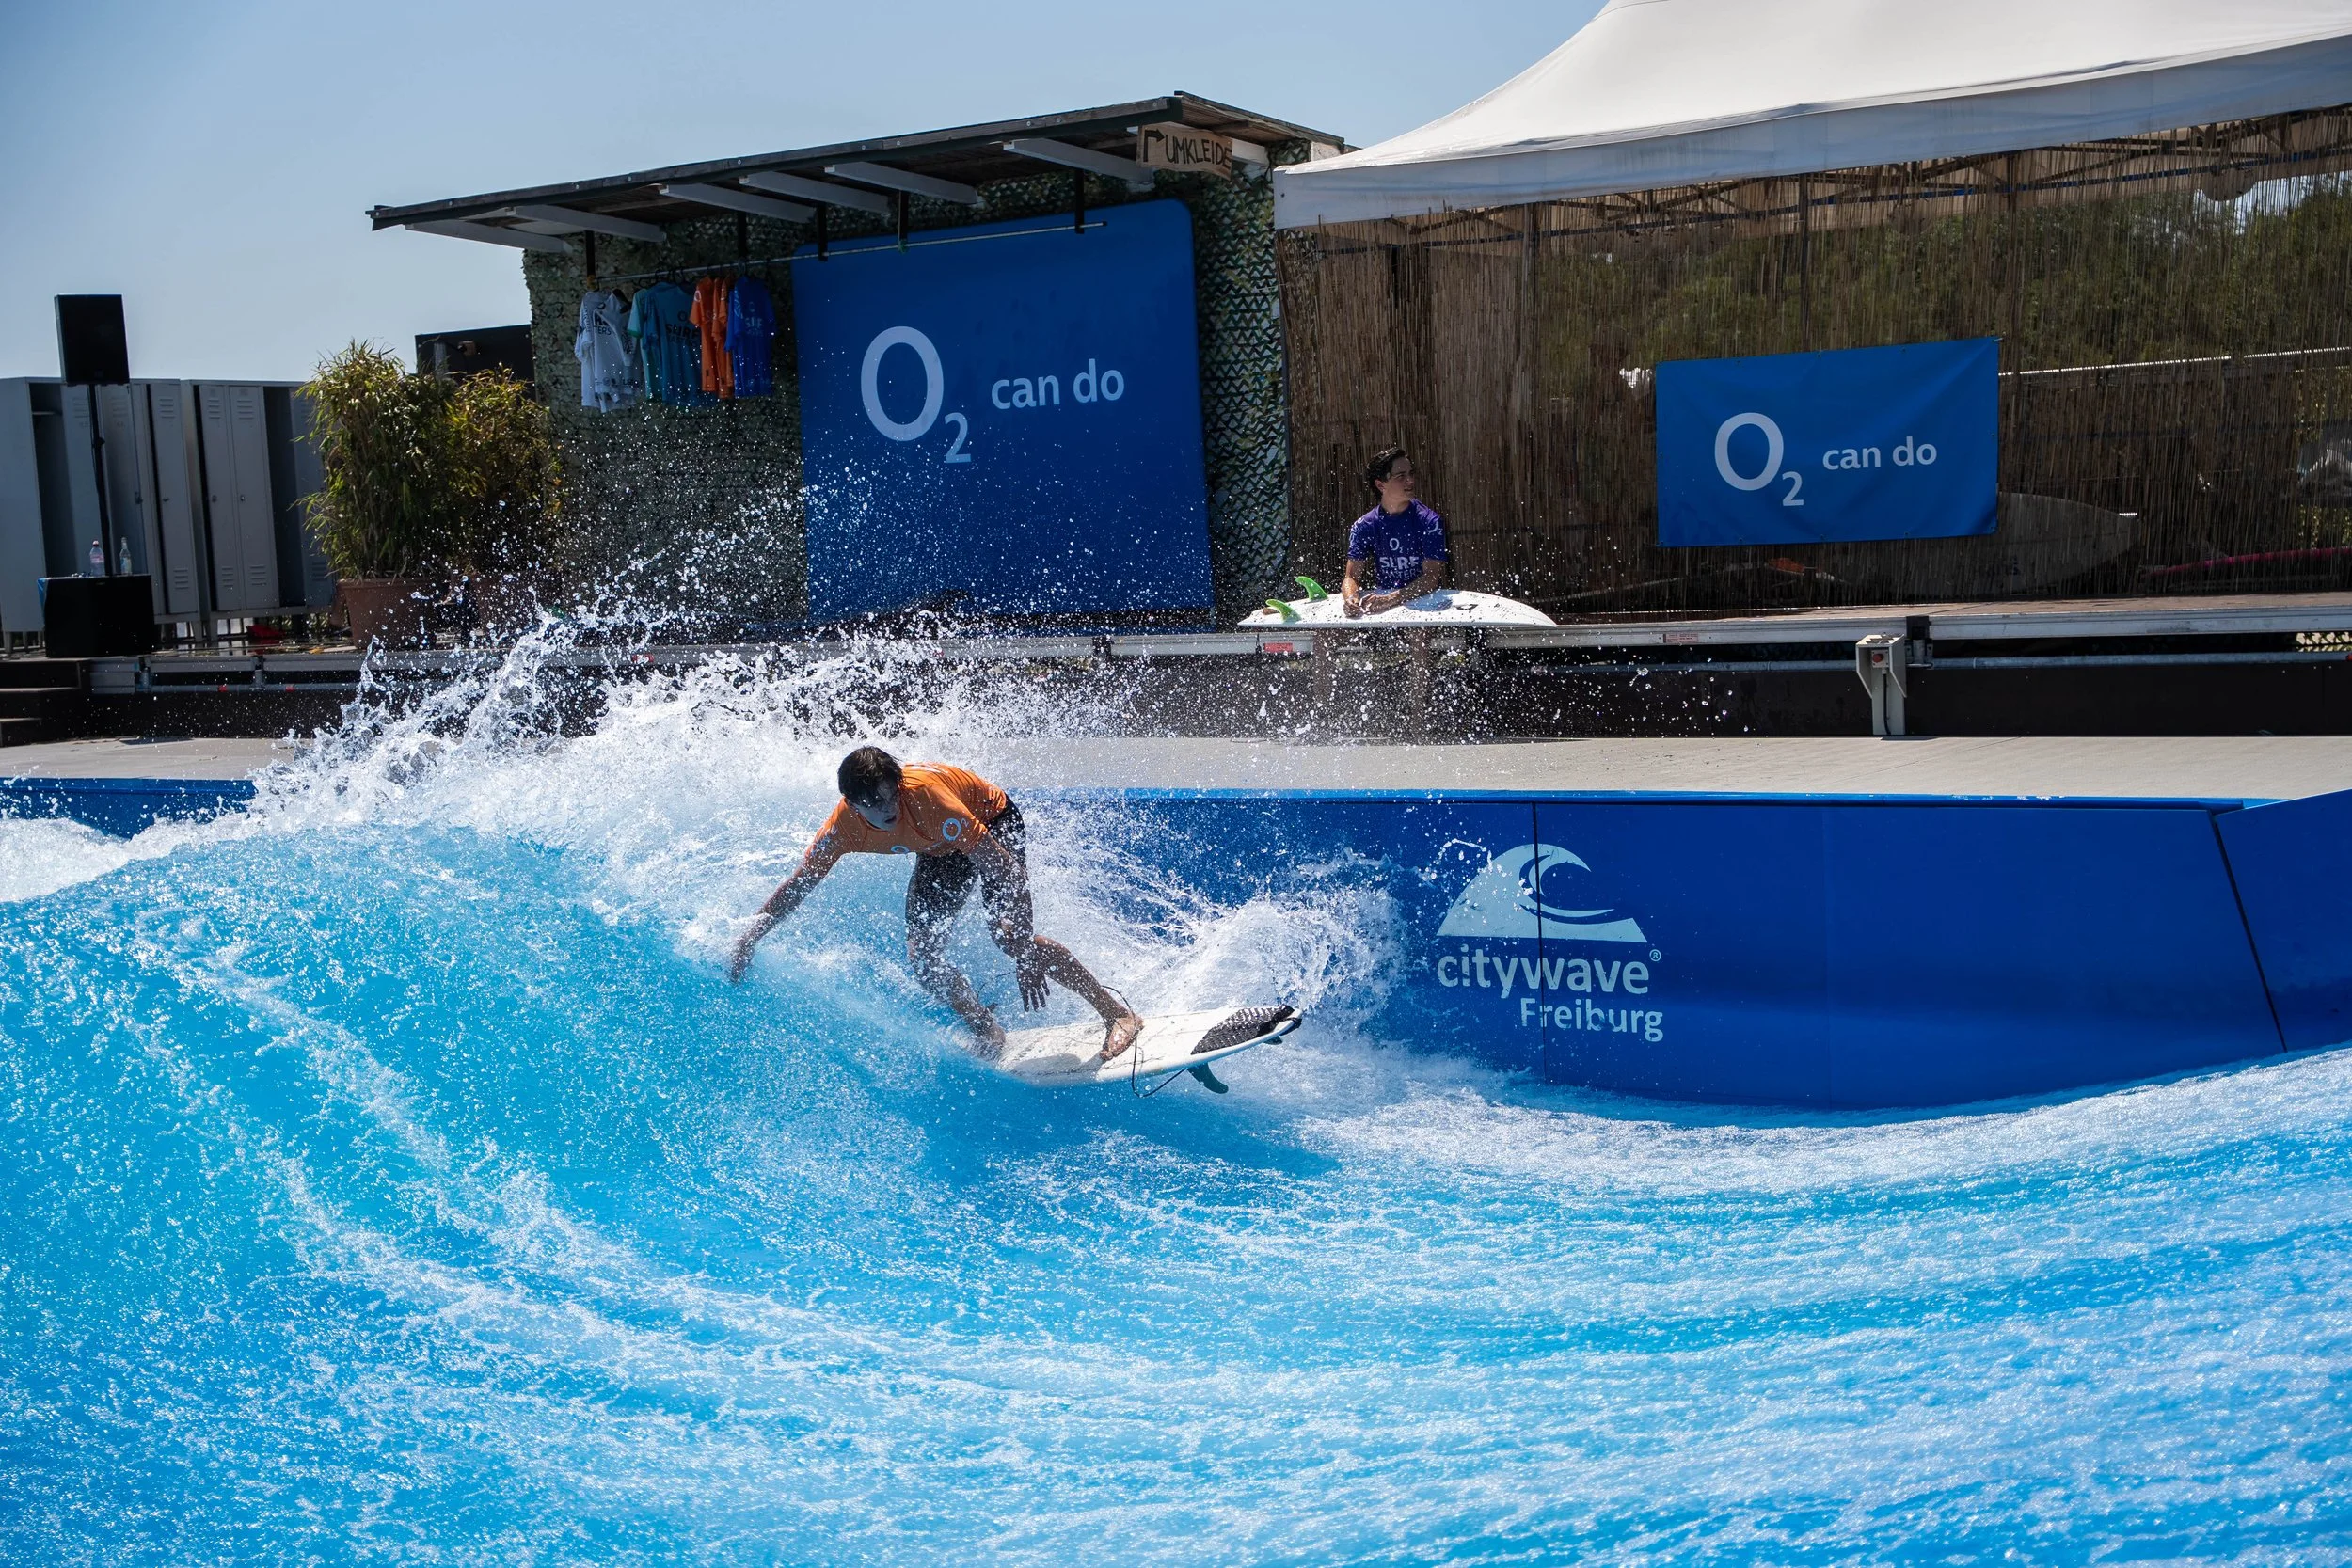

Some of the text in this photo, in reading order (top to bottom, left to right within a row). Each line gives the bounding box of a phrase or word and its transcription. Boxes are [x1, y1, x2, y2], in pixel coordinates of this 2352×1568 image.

[1165, 134, 1232, 168] UMKLEIDE
[991, 374, 1061, 410] can
[1073, 358, 1125, 404] do
[1822, 446, 1881, 470] can
[1892, 436, 1937, 467] do
[1520, 997, 1663, 1042] Freiburg
